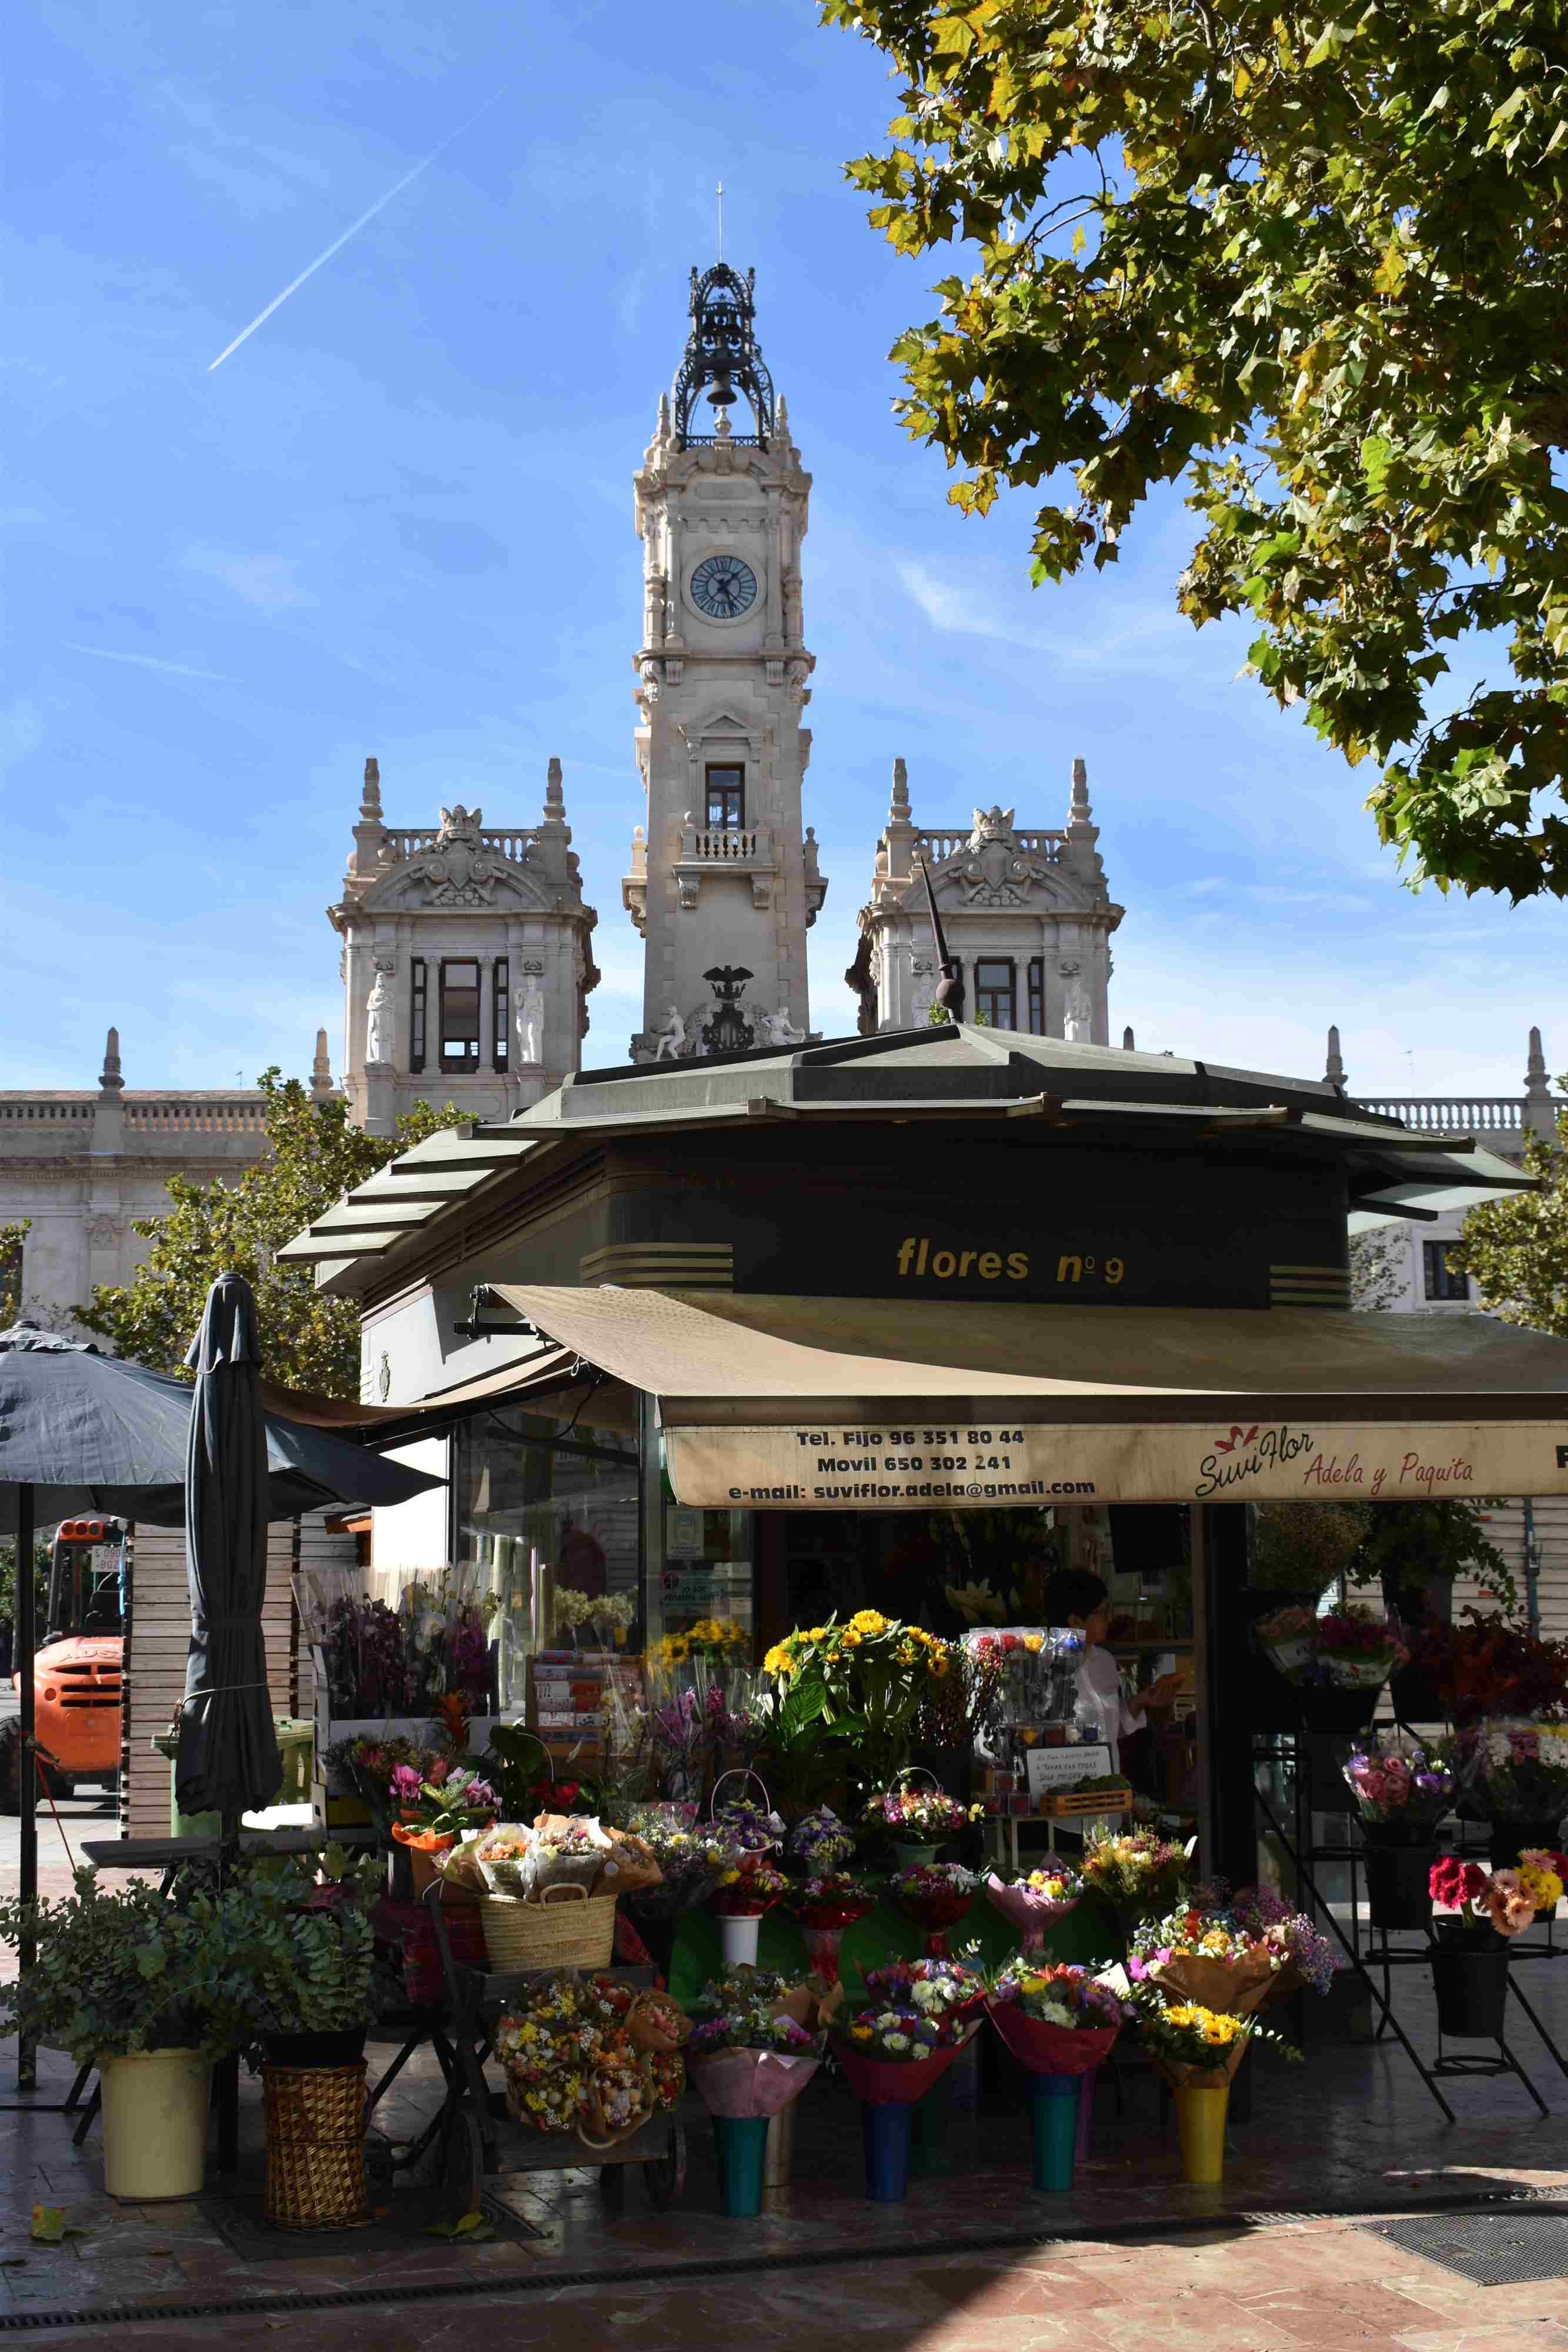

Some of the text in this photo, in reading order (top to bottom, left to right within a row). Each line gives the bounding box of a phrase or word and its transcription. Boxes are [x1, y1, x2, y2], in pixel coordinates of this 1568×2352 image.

[897, 1238, 1029, 1279] flores
[1105, 1257, 1124, 1284] 9
[797, 1430, 1025, 1447] Tel. Fijo 96 351 80 44
[818, 1455, 1011, 1471] Movil 650 302 241
[1303, 1452, 1473, 1495] Adela y Paquita
[728, 1481, 1096, 1499] e-mail: suviflor.adela@gmail.com
